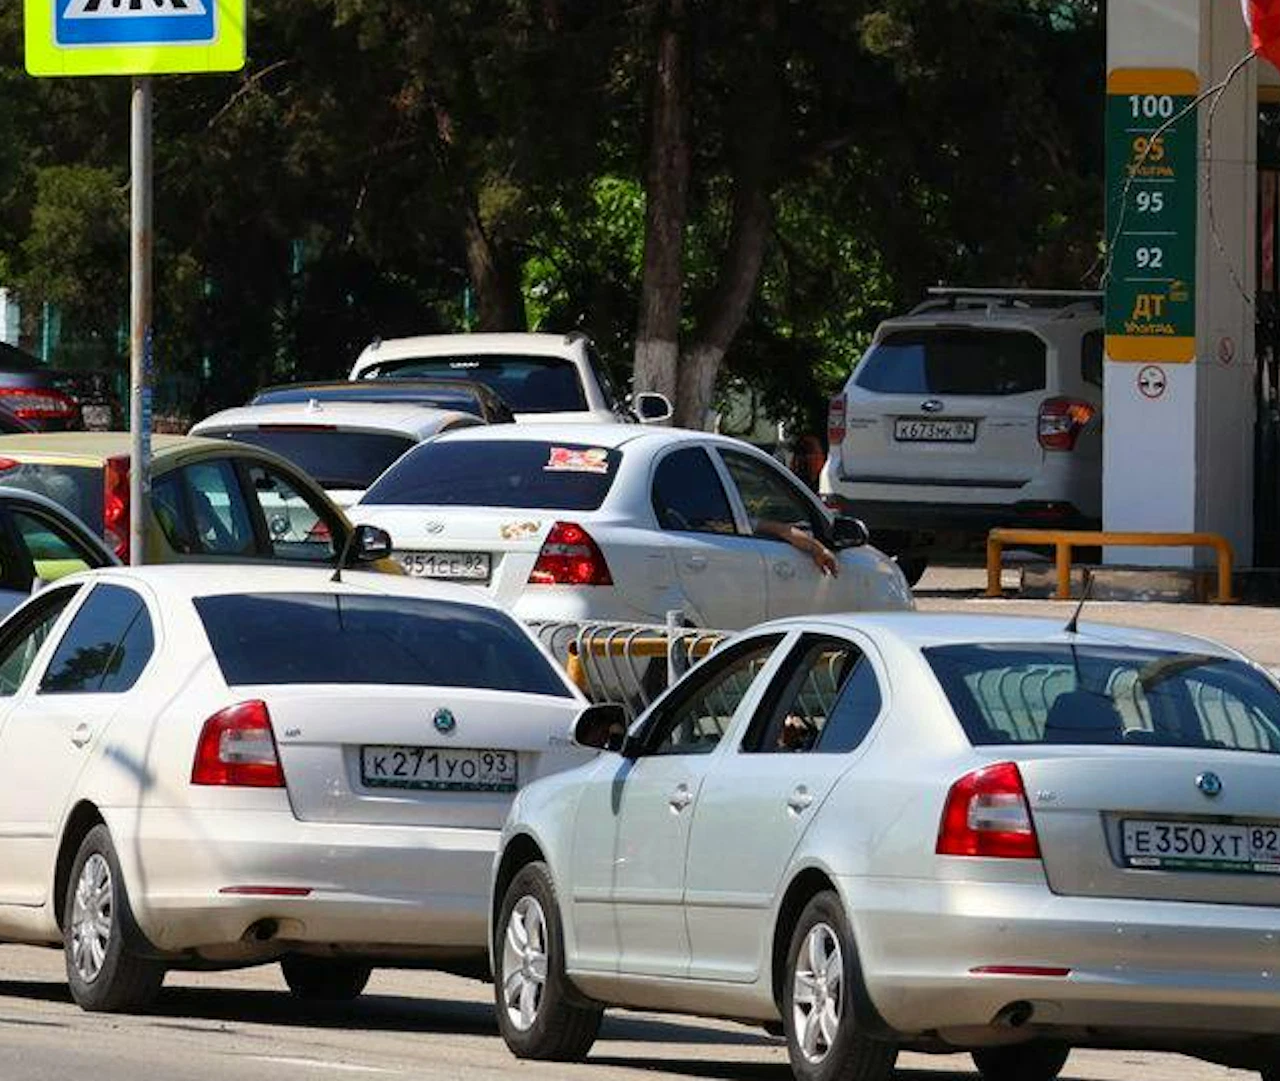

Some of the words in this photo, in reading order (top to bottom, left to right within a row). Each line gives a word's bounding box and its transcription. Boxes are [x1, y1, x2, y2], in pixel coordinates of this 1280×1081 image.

[1129, 95, 1173, 118] 100
[1132, 136, 1165, 161] 95
[1136, 191, 1164, 212] 95
[1135, 248, 1163, 268] 92
[1132, 293, 1166, 322] ДТ
[404, 555, 459, 575] 951СЕ
[483, 753, 508, 772] 93
[1136, 825, 1243, 857] Е350ХТ
[1252, 829, 1278, 851] 82
